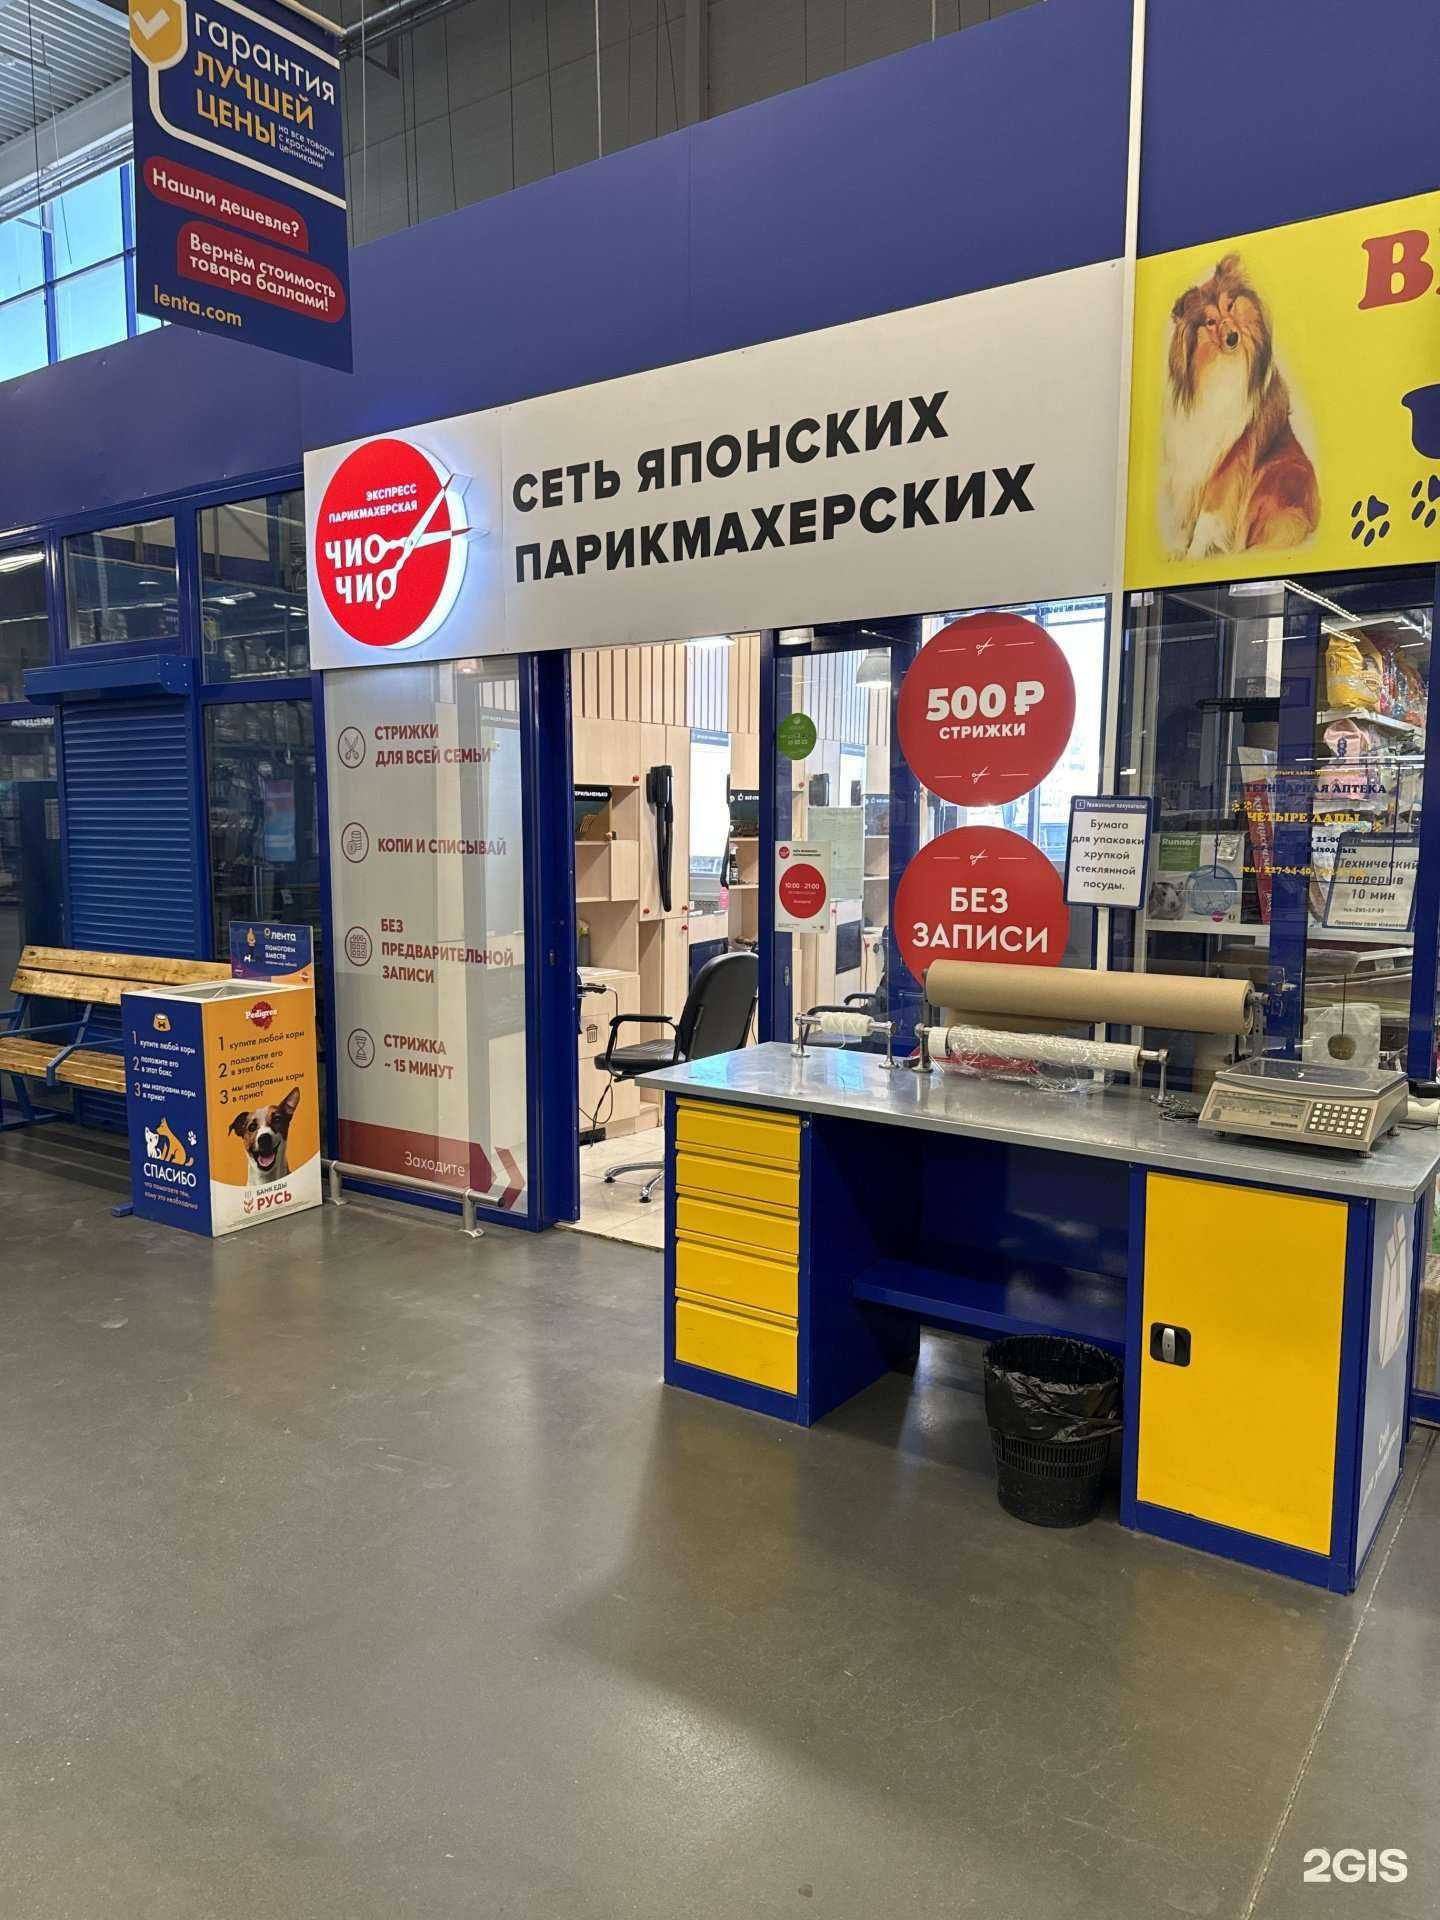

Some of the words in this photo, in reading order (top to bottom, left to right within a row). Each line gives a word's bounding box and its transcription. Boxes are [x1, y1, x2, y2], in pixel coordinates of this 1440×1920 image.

[194, 12, 336, 105] гарантия
[194, 52, 314, 130] ЛУЧШЕЙ
[197, 90, 276, 147] ЦЕНЫ
[278, 125, 290, 135] на
[290, 129, 306, 143] все
[306, 136, 335, 157] товары
[285, 137, 327, 161] красными
[278, 143, 324, 169] ценниками
[153, 167, 216, 208] Нашли
[220, 199, 300, 238] дешевле?
[190, 232, 256, 271] Вернём
[259, 260, 337, 298] стоимость
[1358, 229, 1440, 311] В
[190, 255, 252, 287] товара
[256, 273, 329, 312] баллами!
[153, 284, 243, 327] lenta.com
[512, 459, 621, 513] СЕТЬ
[637, 390, 950, 492] ЯПОНСКИХ
[366, 483, 417, 502] ЭКСПРЕСС
[328, 500, 418, 524] ПАРИКМАХЕРСКАЯ
[515, 462, 1036, 584] ПАРИКМАХЕРСКИХ
[325, 533, 386, 569] ЧИО
[335, 569, 398, 606] ЧИО
[925, 683, 1007, 722] 500
[374, 723, 440, 741] СТРИЖКИ
[939, 722, 1026, 741] СТРИЖКИ
[375, 749, 404, 768] ДЛЯ
[406, 745, 441, 765] ВСЕЙ
[444, 748, 492, 764] СЕМЬИ
[1332, 783, 1387, 794] АПТЕКА
[1090, 819, 1129, 831] Бумага
[1247, 812, 1308, 824] ЧЕТЫРЕ
[1311, 812, 1361, 824] ЛАПЫ
[378, 838, 414, 854] КОПИ
[417, 838, 425, 853] И
[428, 837, 507, 856] СПИСЫВАЙ
[1071, 835, 1091, 844] для
[1093, 836, 1145, 846] упаковки
[1162, 838, 1195, 847] Runner
[1083, 850, 1130, 861] хрупкой
[1075, 864, 1136, 875] стеклянной
[1083, 880, 1125, 891] посуды.
[1348, 876, 1404, 886] перерыв
[950, 886, 1009, 915] БЕЗ
[1352, 889, 1366, 900] 10
[1370, 891, 1395, 901] мин
[380, 918, 404, 934] БЕЗ
[271, 931, 296, 942] лента
[911, 921, 1049, 954] ЗАПИСИ
[381, 941, 514, 967] ПРЕДВАРИТЕЛЬНОЙ
[382, 966, 435, 984] ЗАПИСИ
[218, 1036, 224, 1051] 1
[229, 1038, 257, 1050] купите
[383, 1033, 447, 1055] СТРИЖКА
[132, 1055, 140, 1071] 2
[218, 1063, 227, 1078] 2
[255, 1061, 275, 1071] бокс
[393, 1059, 406, 1073] 15
[408, 1062, 454, 1080] МИНУТ
[134, 1081, 140, 1097] 3
[219, 1089, 229, 1105] 3
[238, 1090, 264, 1102] приют
[404, 1151, 466, 1177] Заходите
[143, 1162, 197, 1187] СПАСИБО
[256, 1188, 273, 1196] БАНК
[273, 1182, 288, 1192] ЕДЫ
[256, 1190, 292, 1210] РУСЬ
